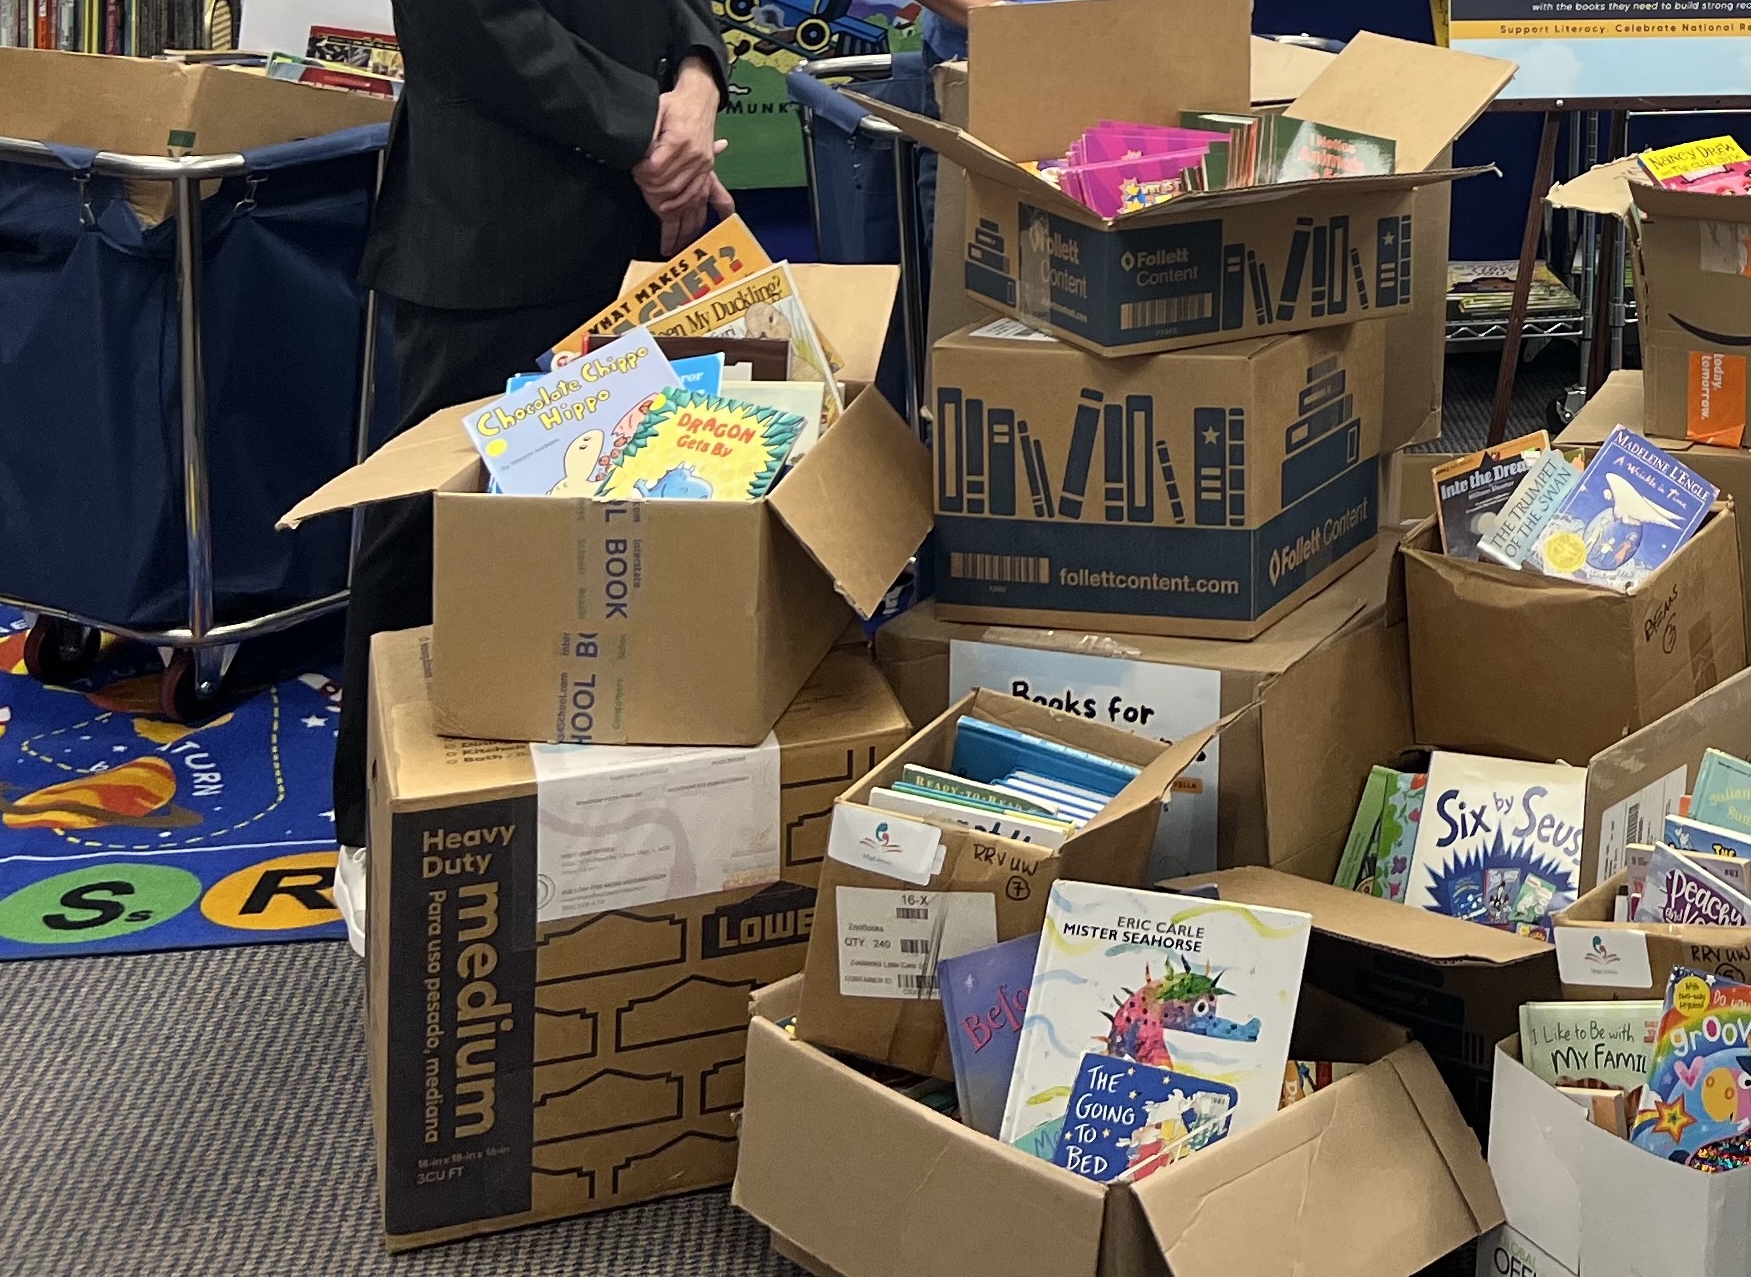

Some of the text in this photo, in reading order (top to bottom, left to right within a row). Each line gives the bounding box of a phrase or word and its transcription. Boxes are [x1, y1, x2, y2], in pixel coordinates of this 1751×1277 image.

[1136, 249, 1190, 268] Follett
[1136, 265, 1199, 287] Content
[686, 274, 782, 337] My Duckling?
[475, 346, 649, 438] Chocolate Chippo
[538, 389, 611, 431] Hippo
[676, 412, 757, 444] DRAGON
[676, 434, 733, 459] Gets By
[1613, 430, 1711, 501] MADELEINE L'ENGLE
[1490, 457, 1558, 551] THE TRUMPET
[1504, 465, 1573, 559] OF THE SWAN
[1059, 568, 1239, 594] follettcontent.com
[1436, 788, 1515, 848] Six by
[421, 824, 516, 852] Heavy
[421, 852, 492, 879] Duty
[901, 894, 930, 907] 16-X
[1063, 923, 1202, 953] MISTER SEAHORSE
[1117, 915, 1205, 939] ERIC CARLE
[844, 938, 865, 948] QTY
[454, 881, 514, 1140] medium
[1088, 1064, 1125, 1094] THE
[1075, 1095, 1136, 1126] GOING
[1074, 1122, 1098, 1145] TO
[1065, 1145, 1108, 1175] BED
